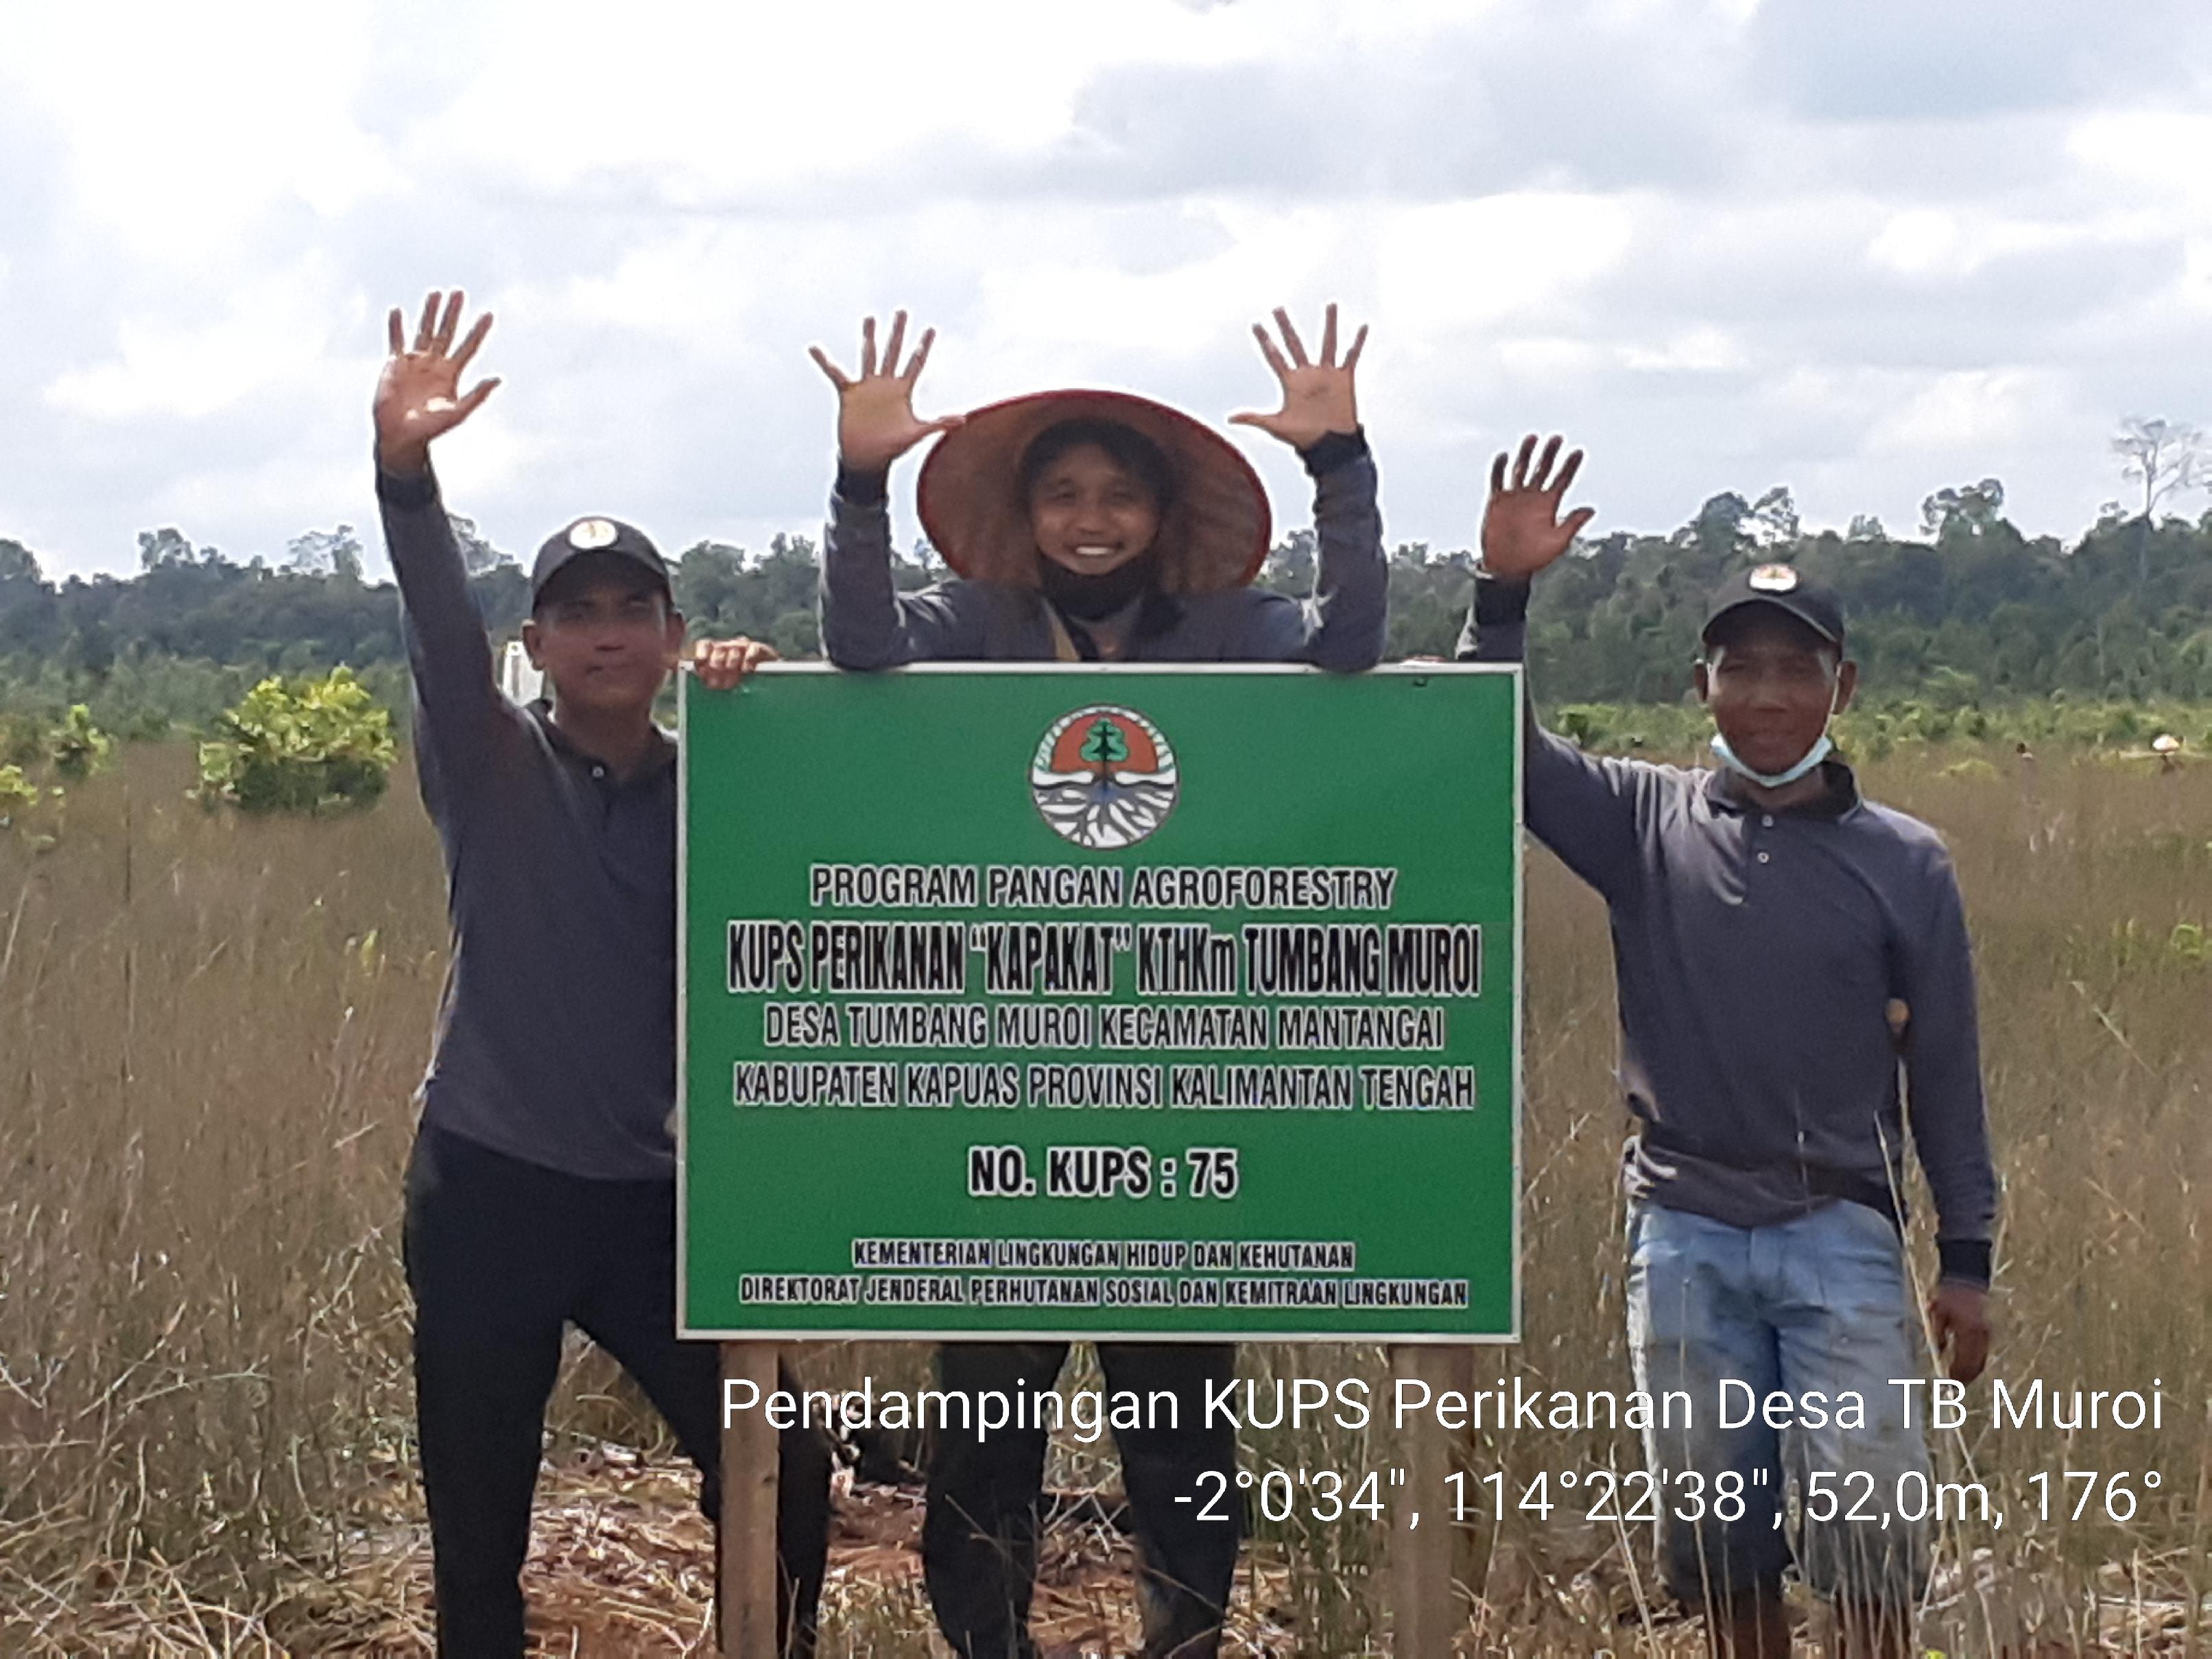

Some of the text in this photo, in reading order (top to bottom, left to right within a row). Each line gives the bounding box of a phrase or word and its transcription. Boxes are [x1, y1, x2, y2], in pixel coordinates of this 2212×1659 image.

[811, 865, 1396, 909] PROGRAM PANGAN AGROFORESTRY
[728, 920, 805, 992] KUPS
[809, 921, 965, 993] PERIKANAN
[1137, 923, 1237, 995] KTHKm
[1242, 924, 1381, 996] TUMBANG
[1386, 924, 1481, 996] MUROI
[765, 1003, 1444, 1050] DESA TUMBANG MUROI KECAMATAN MANTANGAI
[734, 1062, 1475, 1109] KABUPATEN KAPUAS PROVINSI KALIMANTAN TENGAH
[968, 1146, 1036, 1196] NO.
[1047, 1147, 1151, 1197] KUPS
[1187, 1148, 1238, 1198] 75
[853, 1239, 1355, 1271] KEMENTERIAN LINGKUNGAN HIDUP DAN KEHUTANAN
[740, 1274, 1468, 1309] DIREKTORAT JENDERAL PERHUTANAN SOSIAL DAN KEMITRAAN LINGKUNGAN
